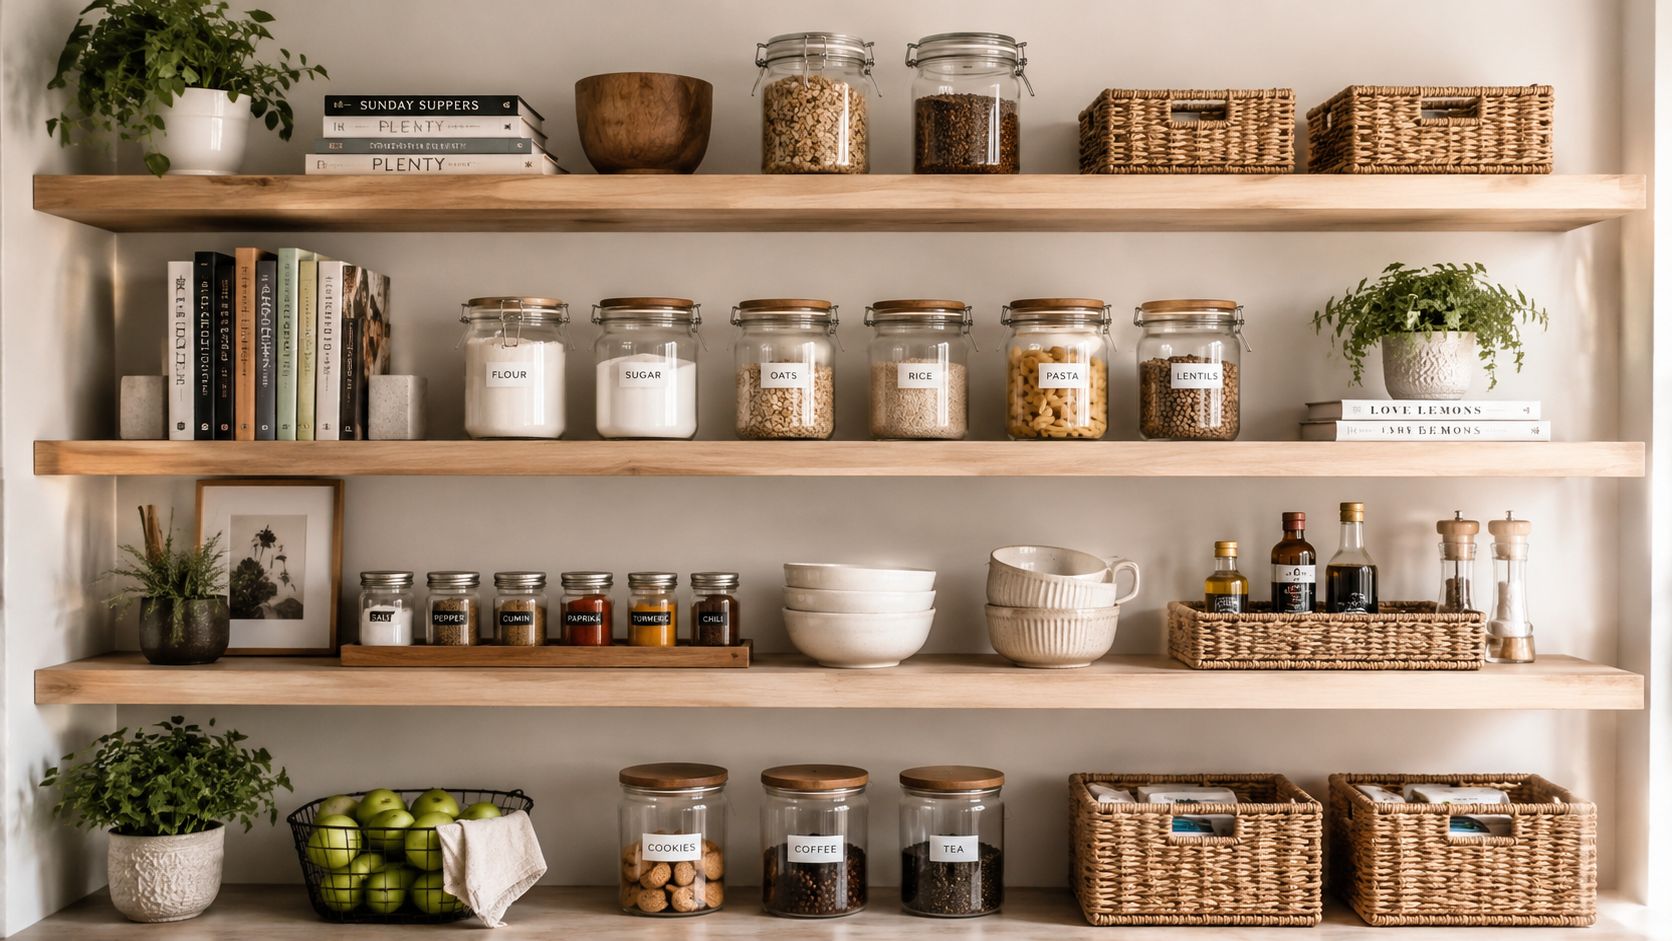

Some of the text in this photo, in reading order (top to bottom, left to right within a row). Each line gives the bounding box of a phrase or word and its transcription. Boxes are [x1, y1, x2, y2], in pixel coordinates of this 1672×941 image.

[360, 100, 414, 110] SUNDAY
[419, 100, 480, 111] SUPPERS
[379, 120, 444, 133] PLENTY
[372, 157, 446, 172] PLENTY
[491, 370, 527, 379] FLOUR
[625, 370, 661, 380] SUGAR
[770, 371, 797, 380] OATS
[908, 371, 933, 380] RICE
[1046, 371, 1080, 380] PASTA
[1176, 371, 1219, 381] LENTILS
[1370, 405, 1412, 415] LOVE
[1418, 405, 1482, 415] LEMONS
[434, 614, 465, 622] PEPPER
[502, 614, 530, 623] CUMIN
[567, 614, 601, 622] PAPRIKA
[648, 843, 696, 853] COOKIES
[794, 845, 837, 854] COFFEE
[943, 845, 965, 854] TEA
